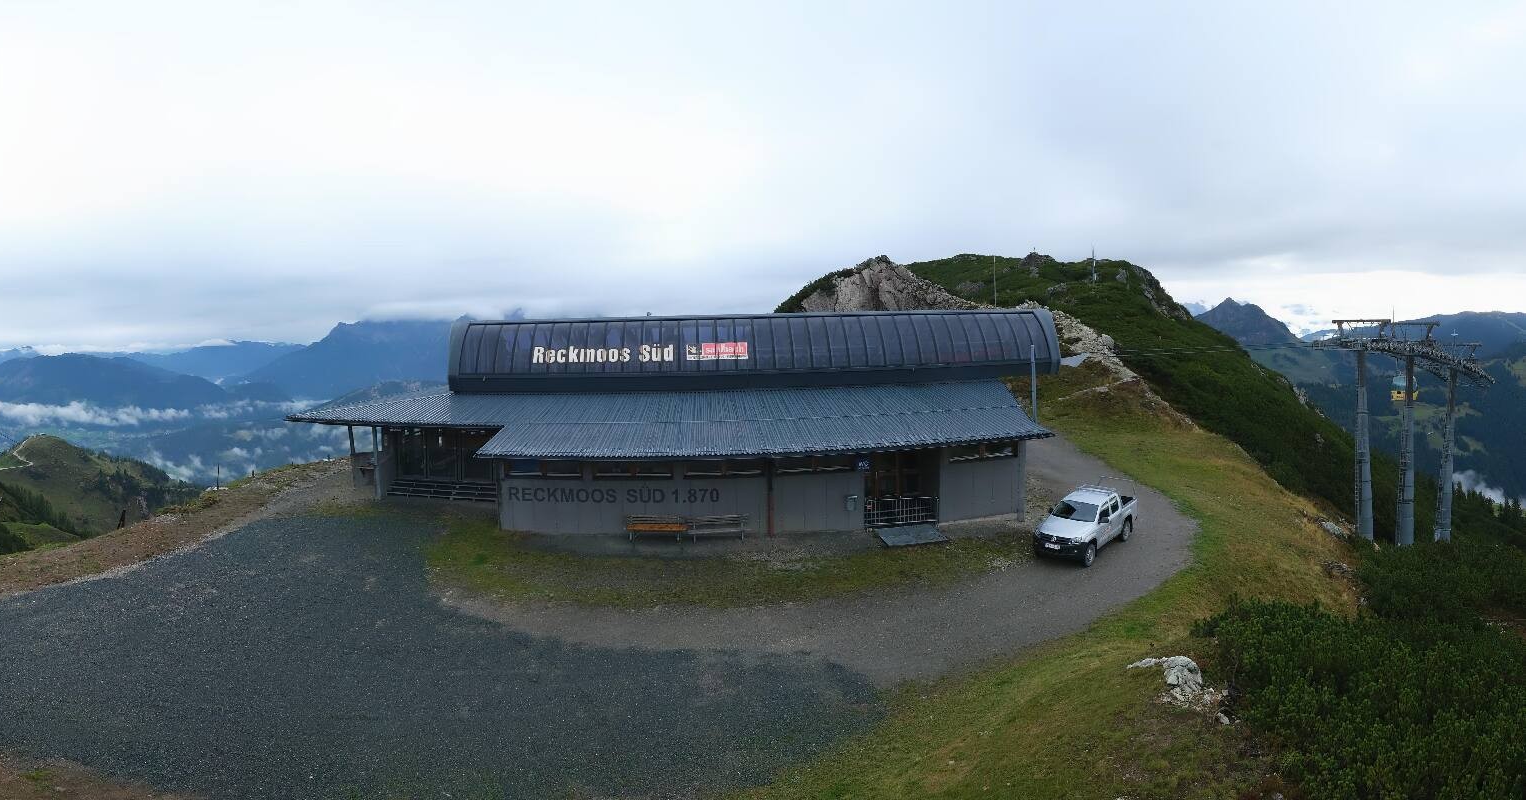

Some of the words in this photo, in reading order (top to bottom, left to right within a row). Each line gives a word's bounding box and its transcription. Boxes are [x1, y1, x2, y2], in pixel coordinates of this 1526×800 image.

[532, 346, 630, 363] Reckmoos
[639, 344, 674, 362] Süd
[508, 487, 617, 503] RECKMOOS
[626, 486, 665, 503] SÜD
[671, 487, 720, 504] 1.870
